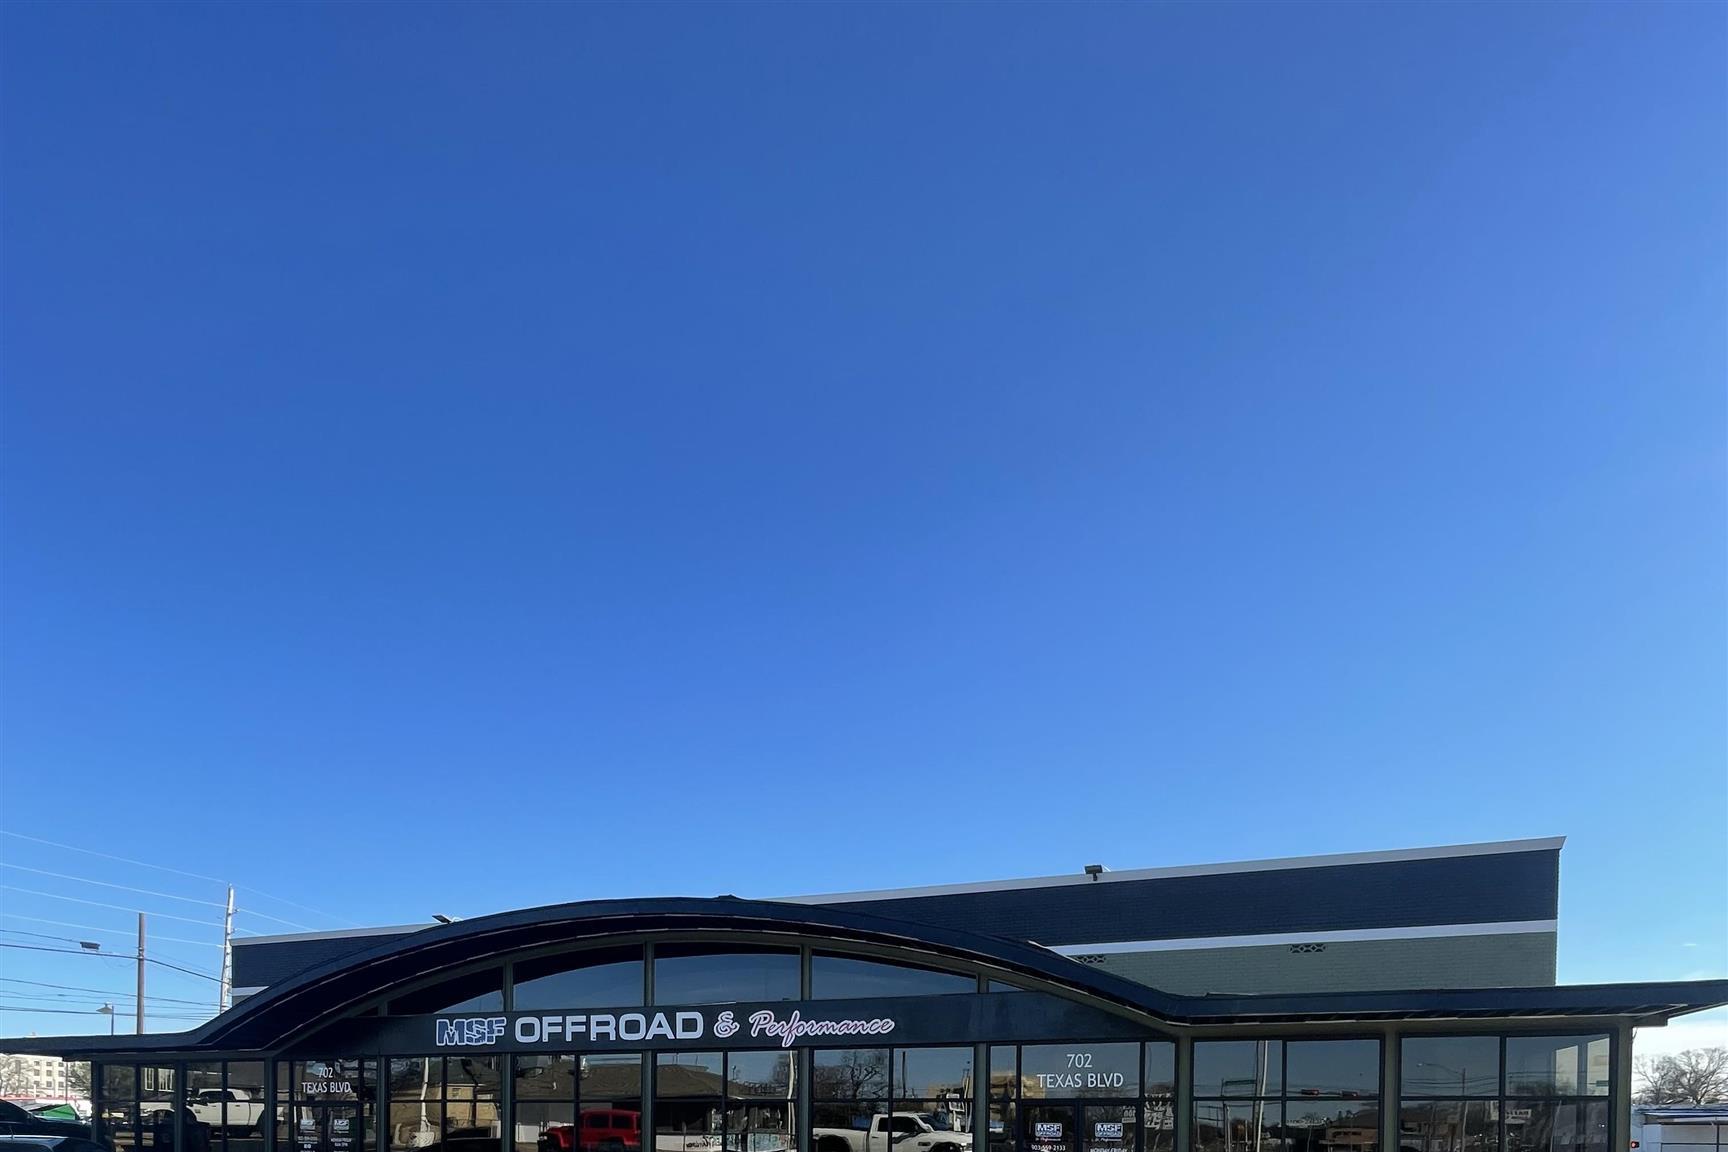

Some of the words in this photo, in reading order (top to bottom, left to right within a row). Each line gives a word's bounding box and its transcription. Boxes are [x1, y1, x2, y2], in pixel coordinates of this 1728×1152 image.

[436, 1017, 507, 1046] MSF
[514, 1011, 704, 1043] OFFROAD
[713, 1011, 740, 1038] &
[749, 1010, 896, 1047] Performance
[1066, 1053, 1093, 1068] 702
[319, 1067, 334, 1078] 702
[302, 1081, 328, 1093] TEXAS
[1037, 1073, 1082, 1088] TEXAS
[1087, 1073, 1124, 1088] BLVD
